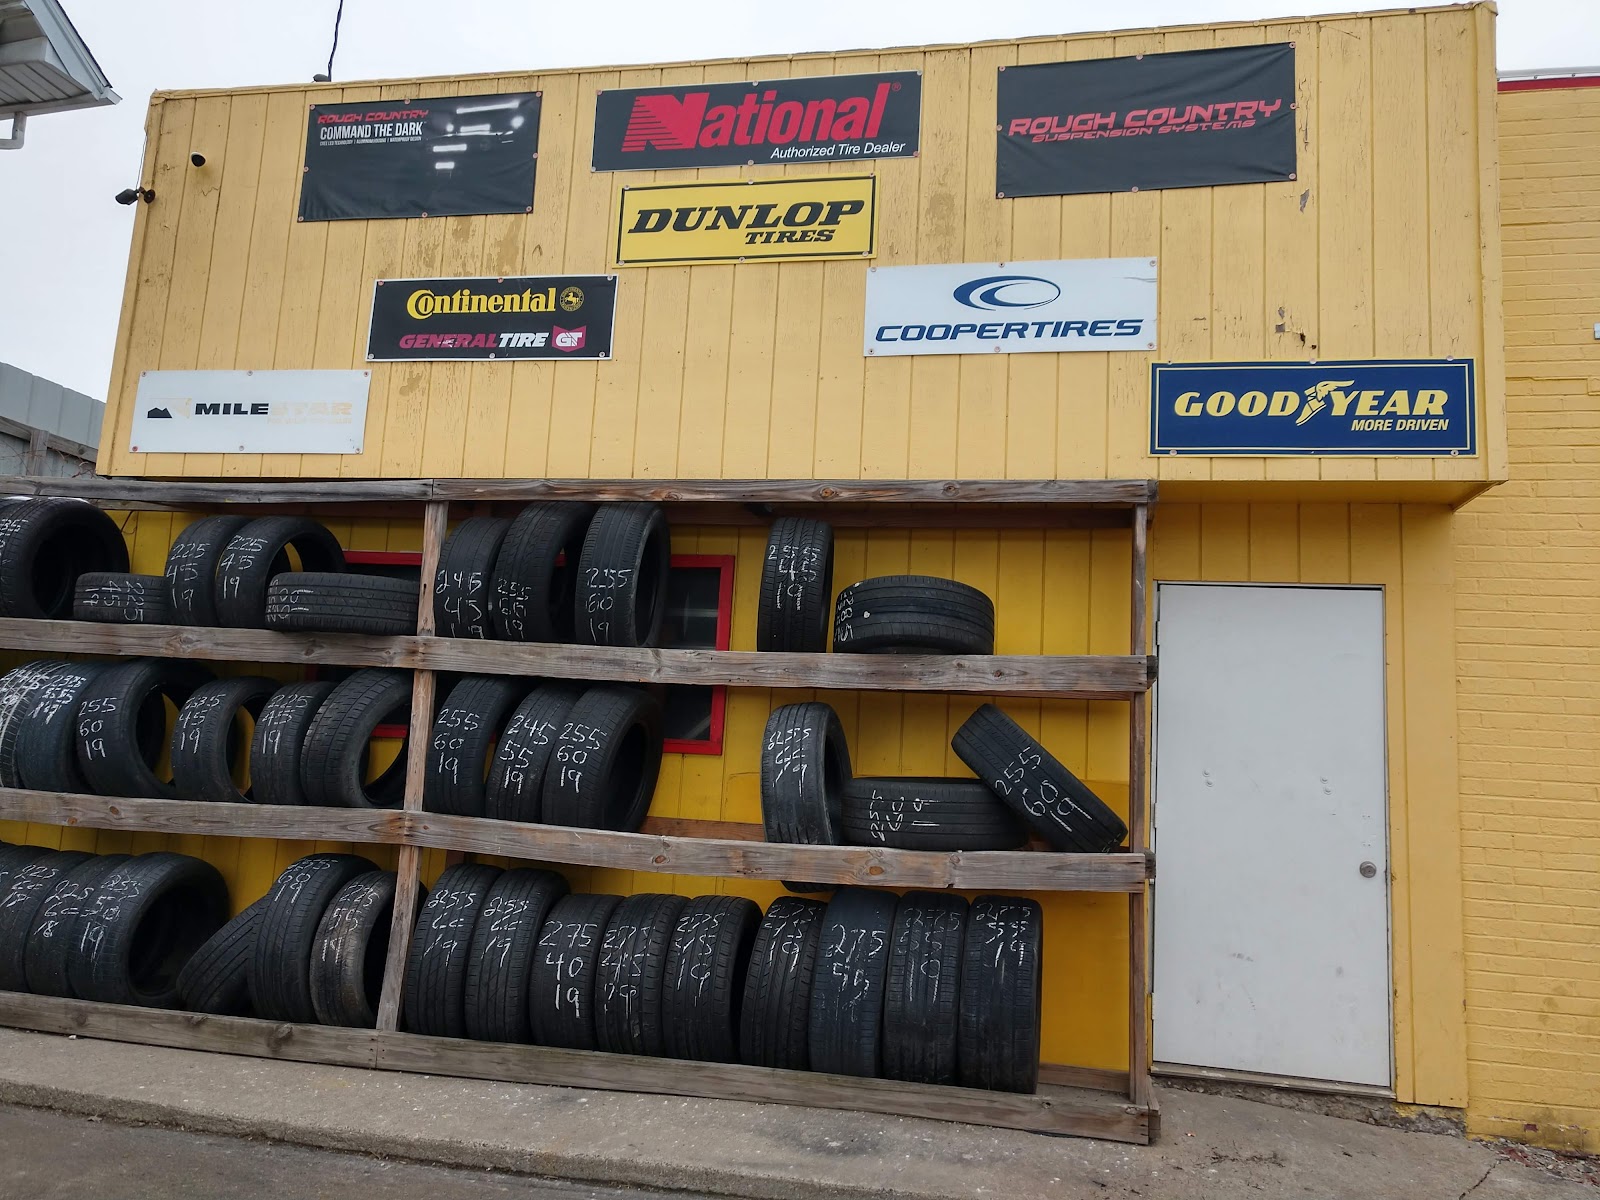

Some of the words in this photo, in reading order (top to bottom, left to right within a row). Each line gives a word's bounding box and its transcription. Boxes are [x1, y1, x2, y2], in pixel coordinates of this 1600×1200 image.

[317, 114, 363, 124] ROUGH
[365, 110, 428, 122] COUNTRY
[621, 82, 891, 152] National
[1008, 112, 1117, 137] ROUGH
[1123, 99, 1282, 128] COUNTRY
[320, 124, 371, 140] COMMAND
[374, 123, 393, 137] THE
[395, 122, 422, 136] DARK
[1031, 127, 1153, 143] SUSPENSION
[1158, 119, 1256, 134] SYSTEMS
[770, 146, 834, 159] Authorized
[838, 143, 860, 155] Tire
[863, 142, 905, 154] Dealer
[628, 200, 865, 234] DUNLOP
[745, 229, 836, 245] TIRES
[406, 287, 557, 320] Continental
[875, 318, 1144, 342] COOPERTIRES
[1351, 419, 1393, 431] MORE
[1395, 418, 1449, 431] DRIVEN
[171, 543, 211, 560] 225
[227, 535, 268, 552] 225
[166, 563, 199, 584] 45
[221, 553, 255, 571] 45
[223, 576, 240, 599] 19
[436, 569, 482, 595] 245
[171, 588, 194, 611] 19
[444, 597, 482, 624] 45
[589, 617, 610, 643] 19
[79, 697, 118, 717] 255
[267, 693, 314, 709] 225
[80, 718, 104, 737] 60
[178, 709, 207, 729] 45
[262, 709, 296, 727] 45
[437, 708, 480, 731] 255
[507, 713, 557, 746] 245
[180, 727, 201, 754] 19
[262, 729, 281, 755] 19
[434, 732, 465, 751] 60
[559, 722, 608, 750] 255
[85, 738, 106, 761] 19
[499, 739, 534, 769] 55
[556, 744, 588, 765] 60
[438, 751, 459, 786] 19
[504, 765, 525, 795] 19
[560, 765, 583, 794] 19
[995, 746, 1041, 795] 255
[1021, 779, 1059, 817] 60
[1049, 797, 1093, 832] 19
[428, 889, 476, 910] 255
[484, 897, 530, 917] 255
[33, 919, 60, 938] 18
[329, 907, 362, 932] 55
[80, 921, 108, 963] 19
[539, 921, 598, 949] 275
[825, 923, 886, 963] 275
[481, 935, 511, 968] 19
[769, 940, 800, 973] 19
[994, 940, 1026, 968] 19
[545, 952, 584, 981] 40
[909, 959, 941, 1003] 19
[555, 984, 581, 1019] 19
